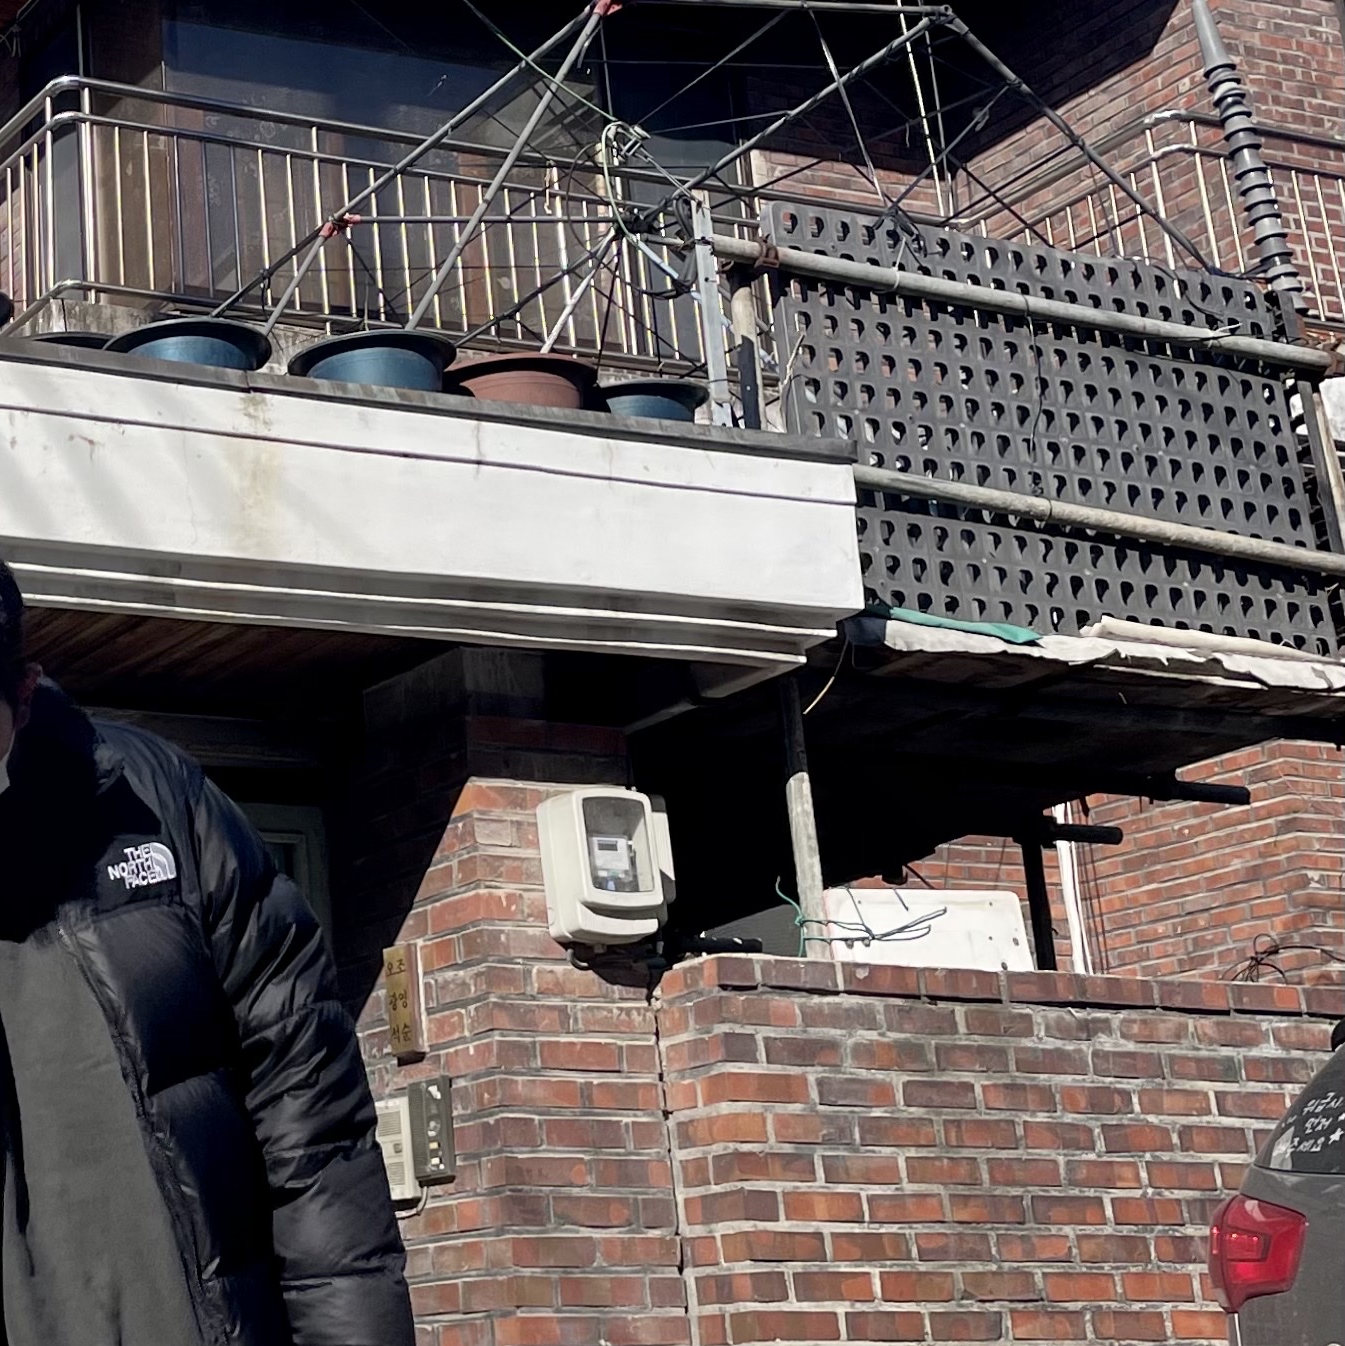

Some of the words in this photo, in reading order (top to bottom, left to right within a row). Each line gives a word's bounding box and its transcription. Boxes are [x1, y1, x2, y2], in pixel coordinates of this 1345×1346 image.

[123, 843, 153, 861] THE
[107, 856, 156, 880] NORTH
[125, 871, 157, 889] FACE
